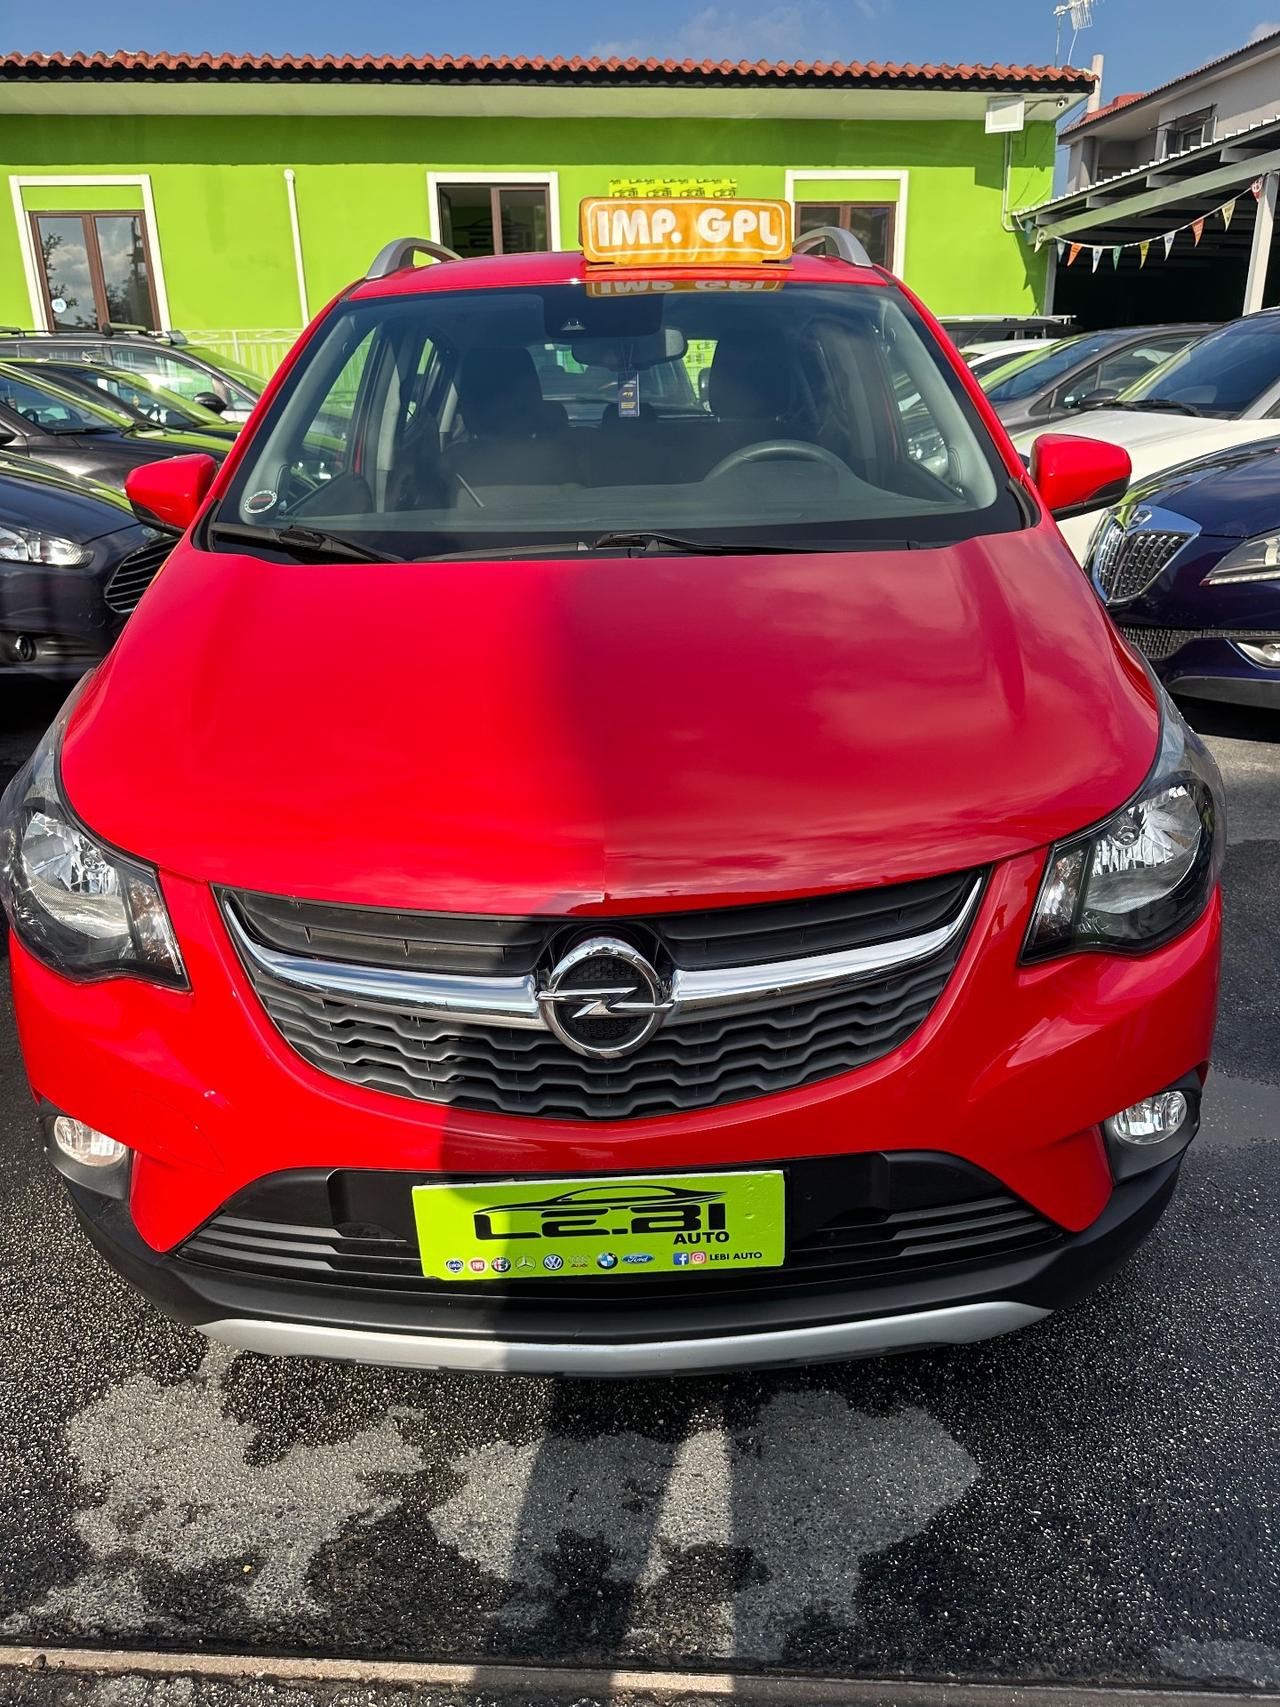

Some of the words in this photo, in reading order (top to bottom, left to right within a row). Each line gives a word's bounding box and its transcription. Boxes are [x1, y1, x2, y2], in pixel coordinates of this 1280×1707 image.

[597, 208, 682, 247] IMP.
[696, 207, 778, 245] GPL
[673, 1231, 730, 1245] AUTO
[709, 1252, 730, 1261] LEBI
[733, 1251, 763, 1260] AUTO
